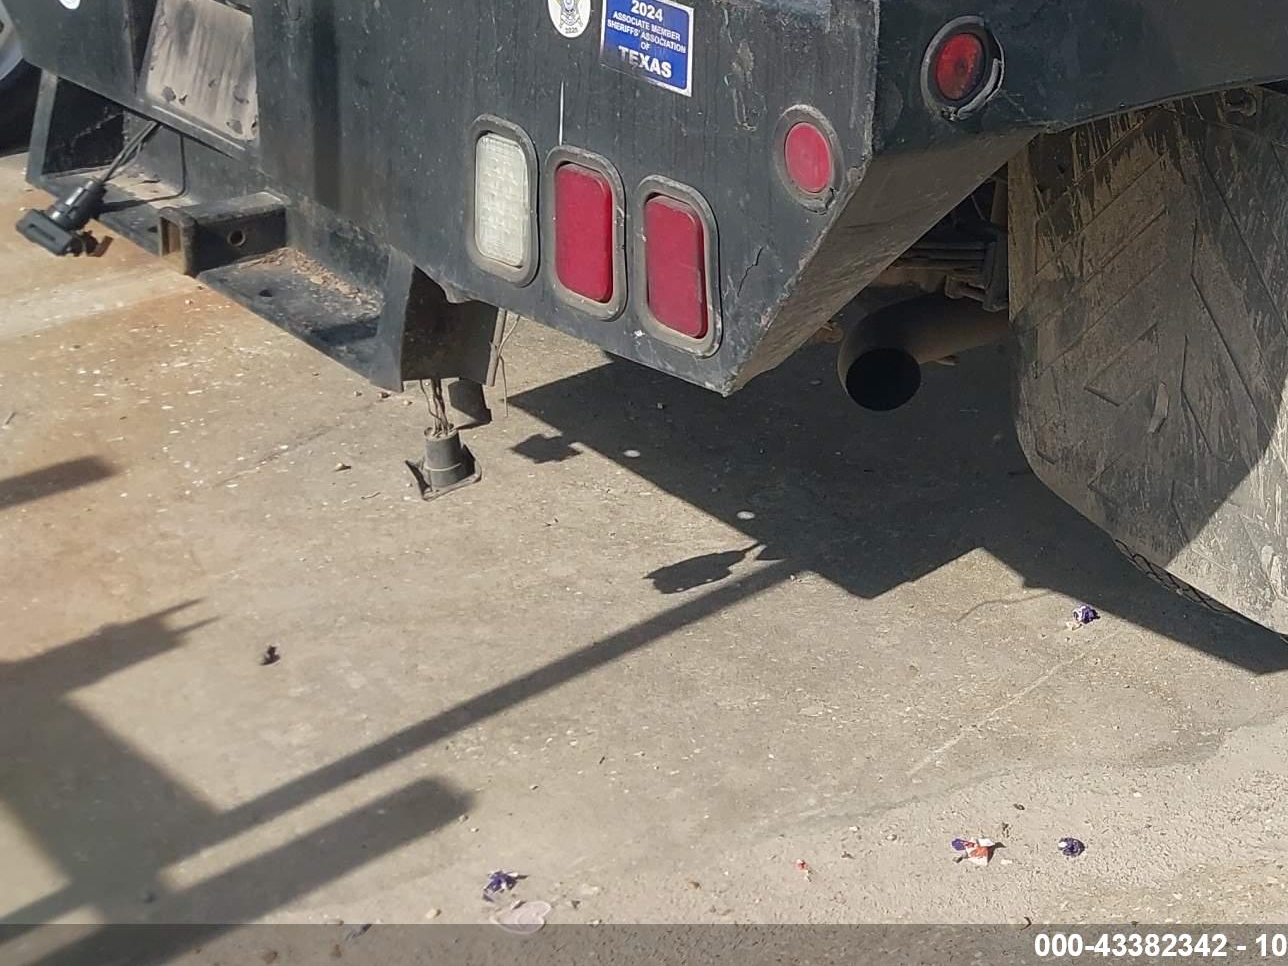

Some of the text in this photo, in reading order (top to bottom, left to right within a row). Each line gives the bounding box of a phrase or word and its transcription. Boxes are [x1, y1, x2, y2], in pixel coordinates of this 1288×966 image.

[631, 0, 663, 22] 2024
[612, 10, 682, 41] ASSOCIATE MEMBER
[640, 31, 687, 54] ASSOCIATION
[640, 41, 651, 51] OF
[618, 45, 673, 78] TEXAS
